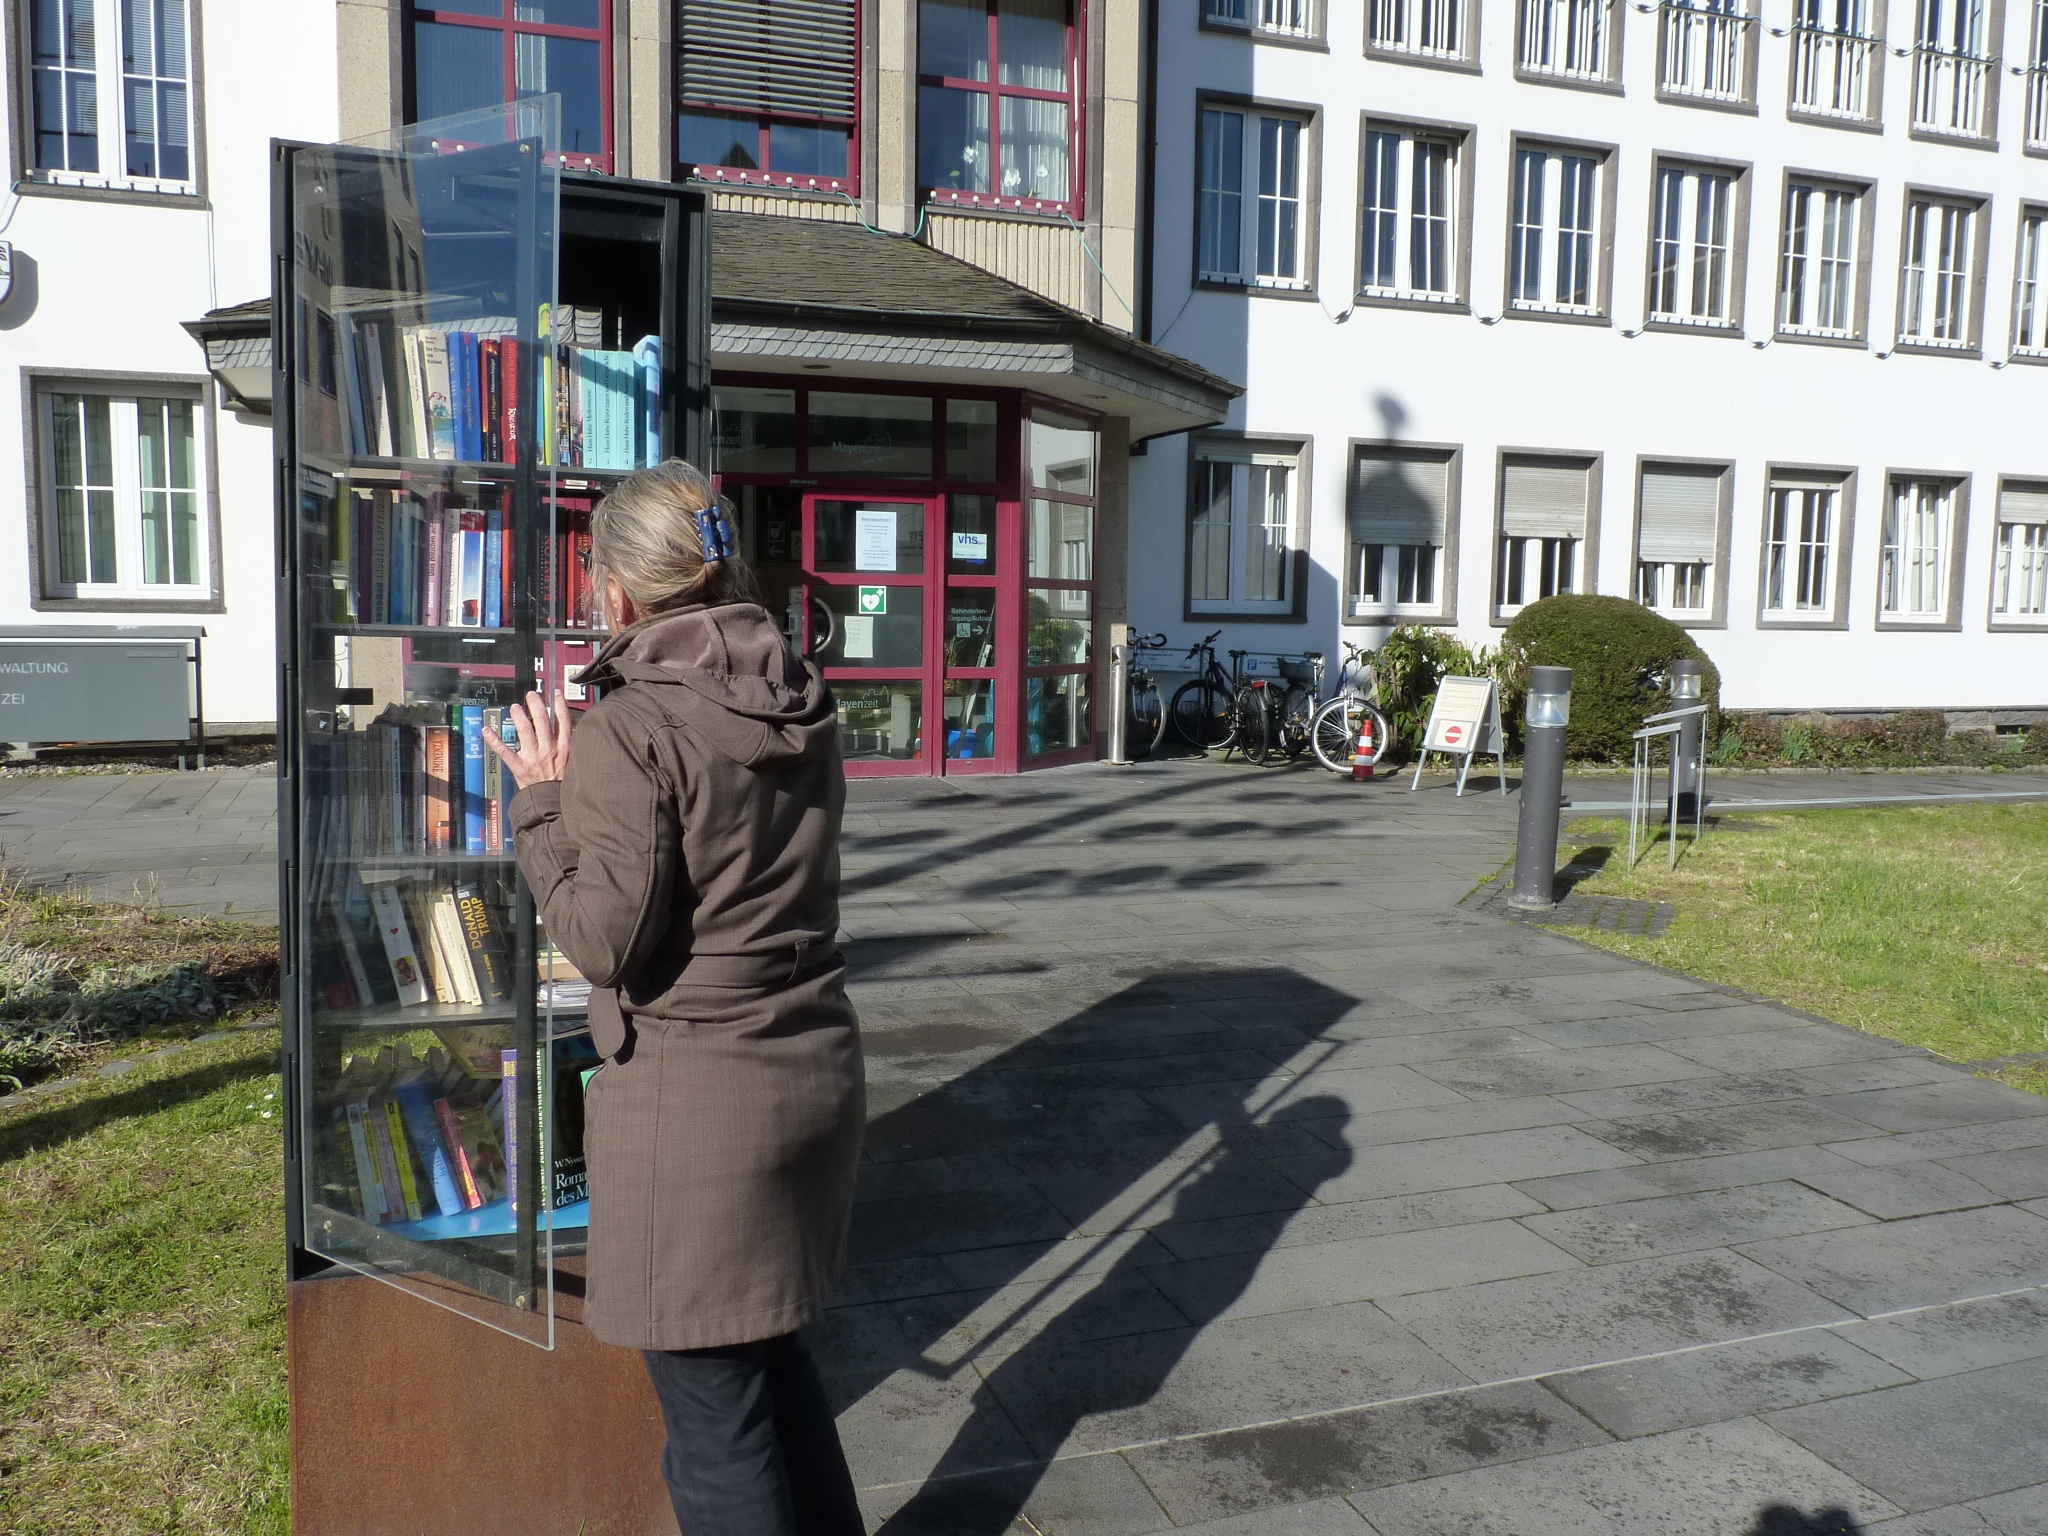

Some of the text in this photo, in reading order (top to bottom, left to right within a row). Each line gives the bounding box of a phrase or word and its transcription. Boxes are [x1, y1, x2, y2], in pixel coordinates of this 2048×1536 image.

[958, 533, 978, 545] vhs
[432, 740, 445, 773] EMINENZA
[460, 899, 483, 950] DONALD
[471, 897, 491, 937] TRUMP
[555, 1171, 587, 1190] Roma
[556, 1182, 591, 1206] des M
